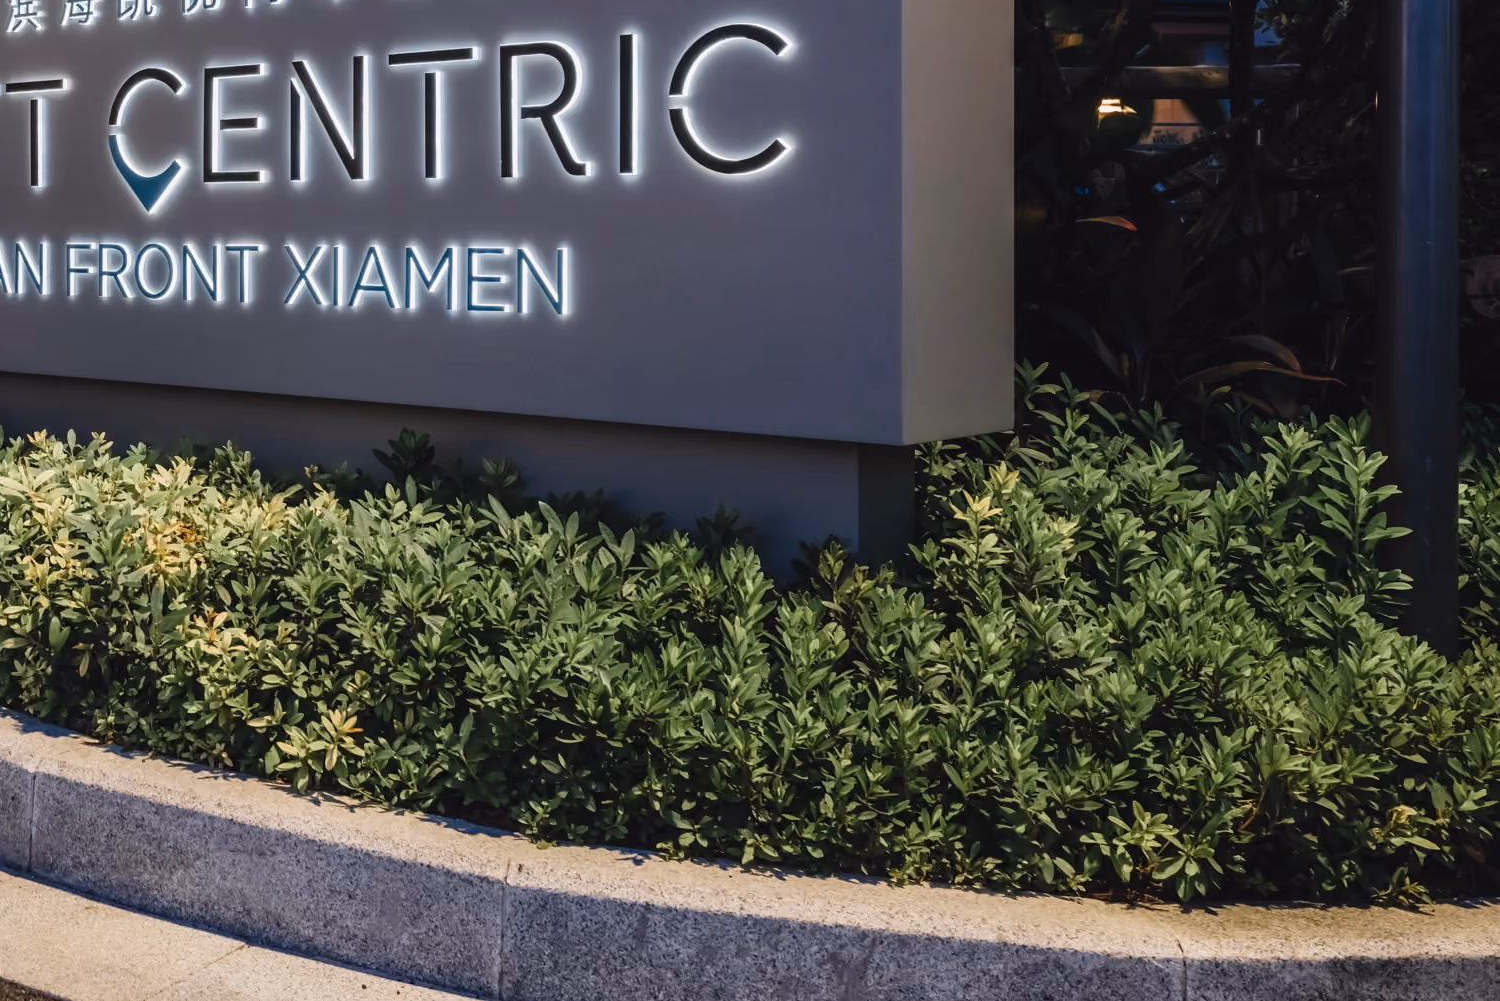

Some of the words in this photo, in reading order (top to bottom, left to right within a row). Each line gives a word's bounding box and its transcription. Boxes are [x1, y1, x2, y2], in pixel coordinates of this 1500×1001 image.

[106, 21, 795, 214] CENTRIC
[66, 240, 266, 303] FRONT
[283, 243, 570, 316] XIAMEN
